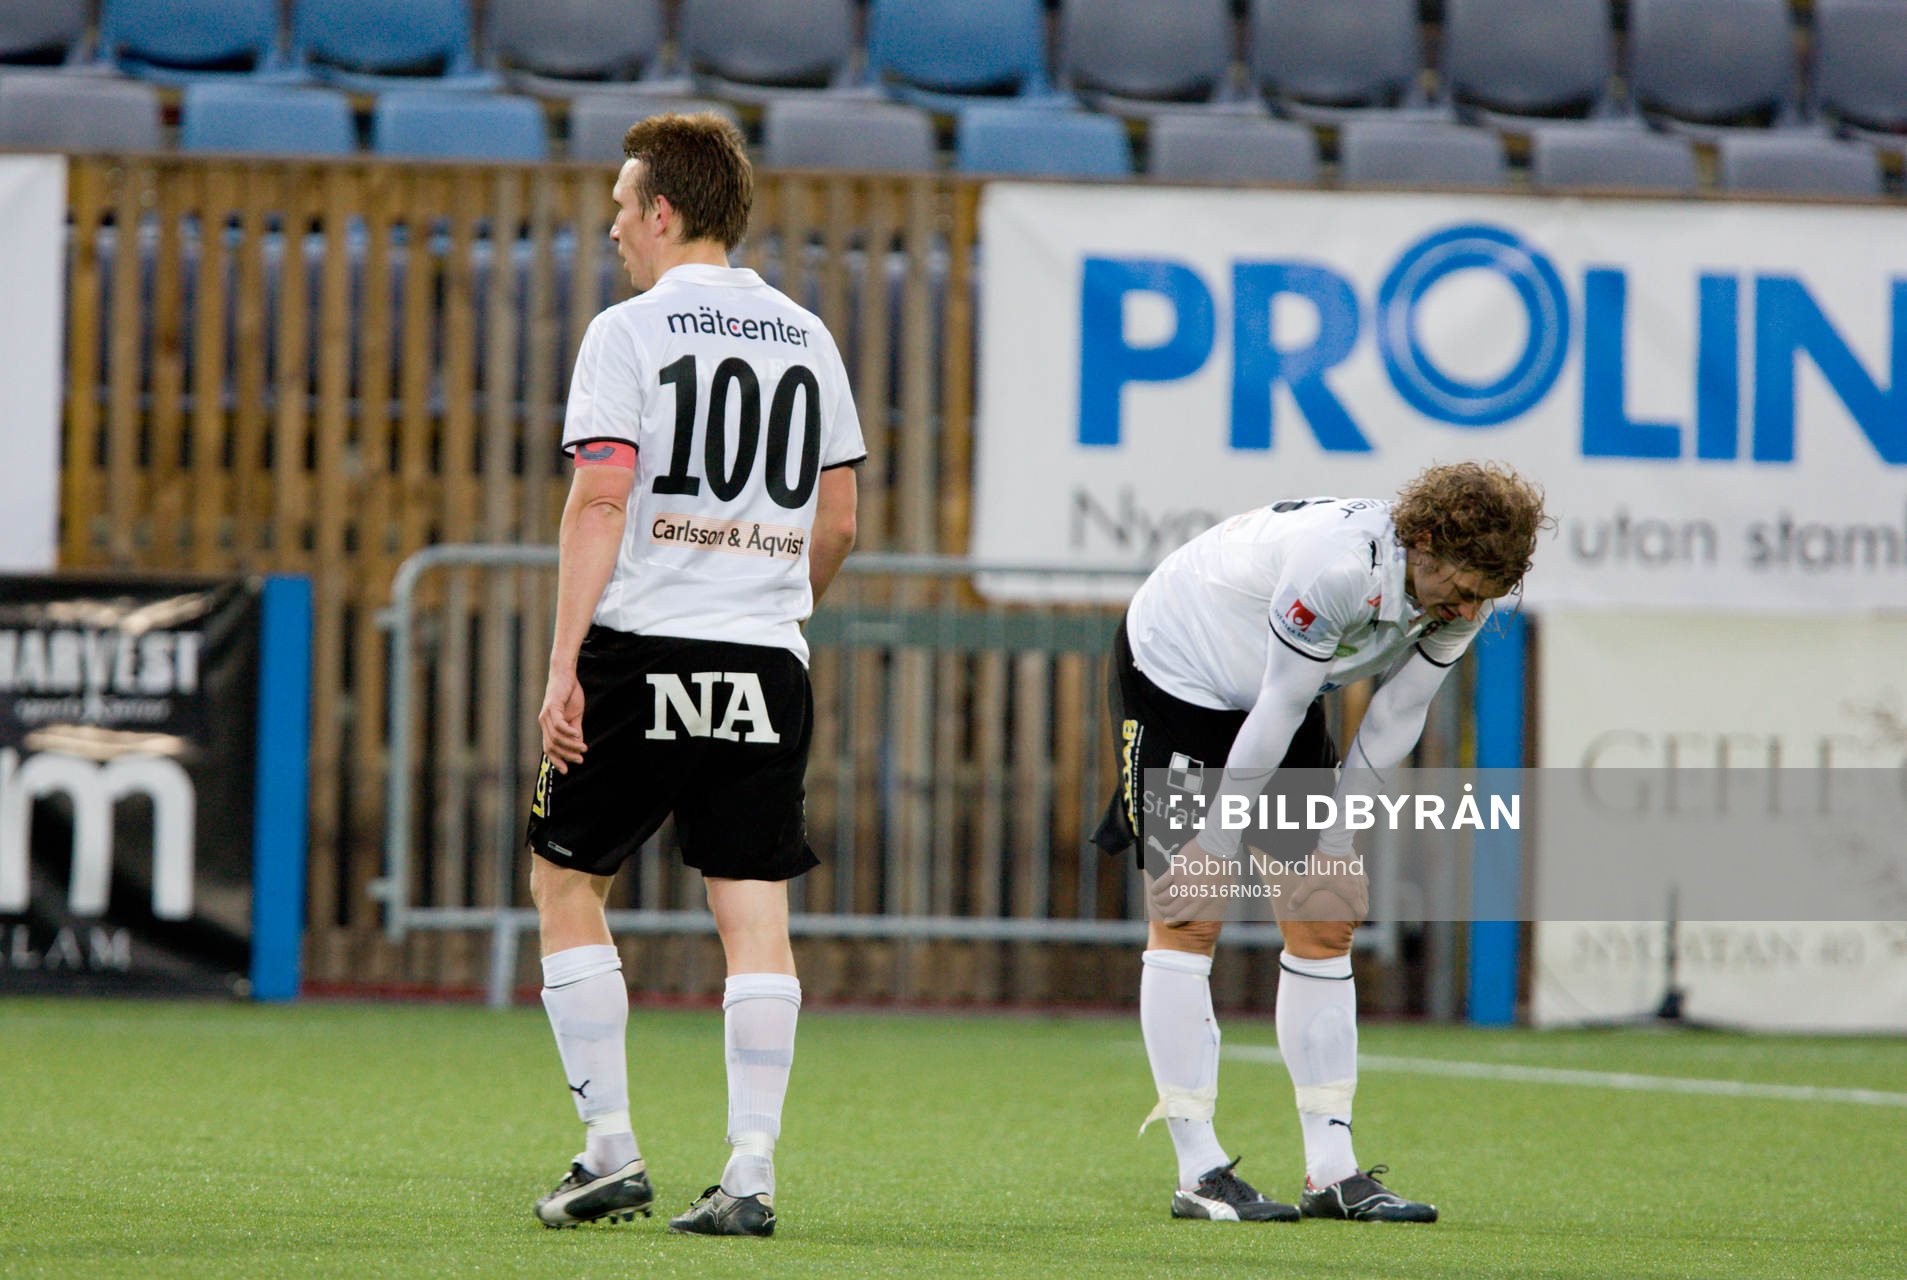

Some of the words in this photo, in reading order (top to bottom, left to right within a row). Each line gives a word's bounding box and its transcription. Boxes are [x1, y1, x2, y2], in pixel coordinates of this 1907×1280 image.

[667, 306, 809, 347] mätcenter
[652, 354, 822, 509] 100
[652, 518, 724, 546] Carlsson
[727, 528, 741, 548] &
[747, 523, 804, 558] Åqvist
[1570, 505, 1718, 567] utan
[1747, 498, 1907, 572] stam
[645, 671, 780, 744] NA
[0, 924, 131, 972] LAM
